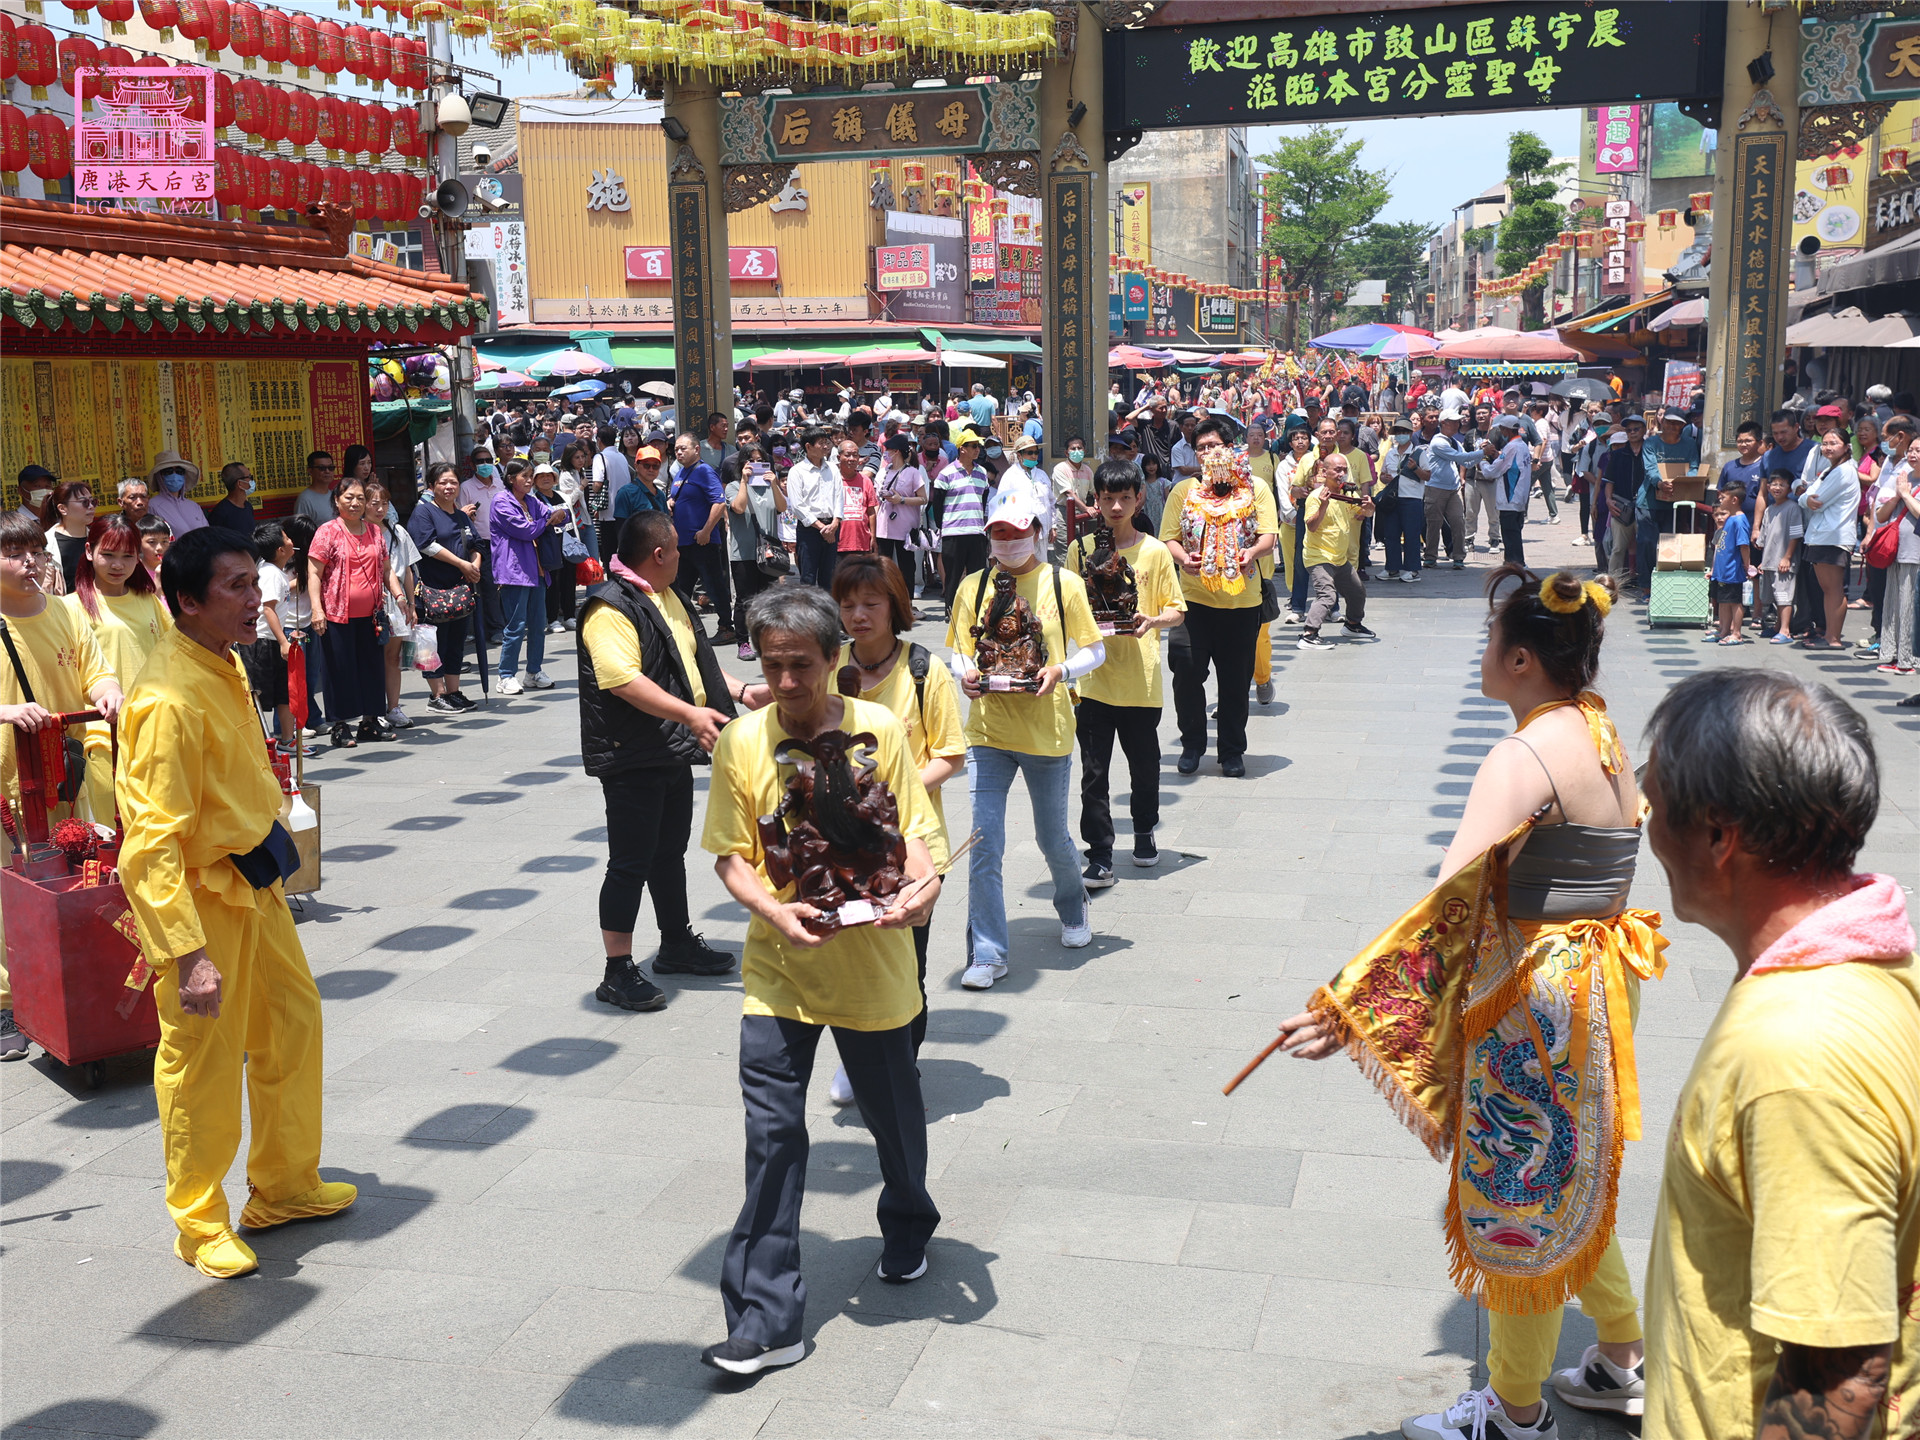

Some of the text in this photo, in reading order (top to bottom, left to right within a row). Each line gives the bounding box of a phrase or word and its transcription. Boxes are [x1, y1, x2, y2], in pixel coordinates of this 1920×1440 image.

[1188, 8, 1627, 74] 歡迎高雄市鼓山區蘇宇晨
[1246, 56, 1562, 110] 蒞臨本宮分靈聖母
[357, 237, 369, 254] 府
[971, 241, 993, 255] 總店
[971, 257, 994, 270] 百年老店
